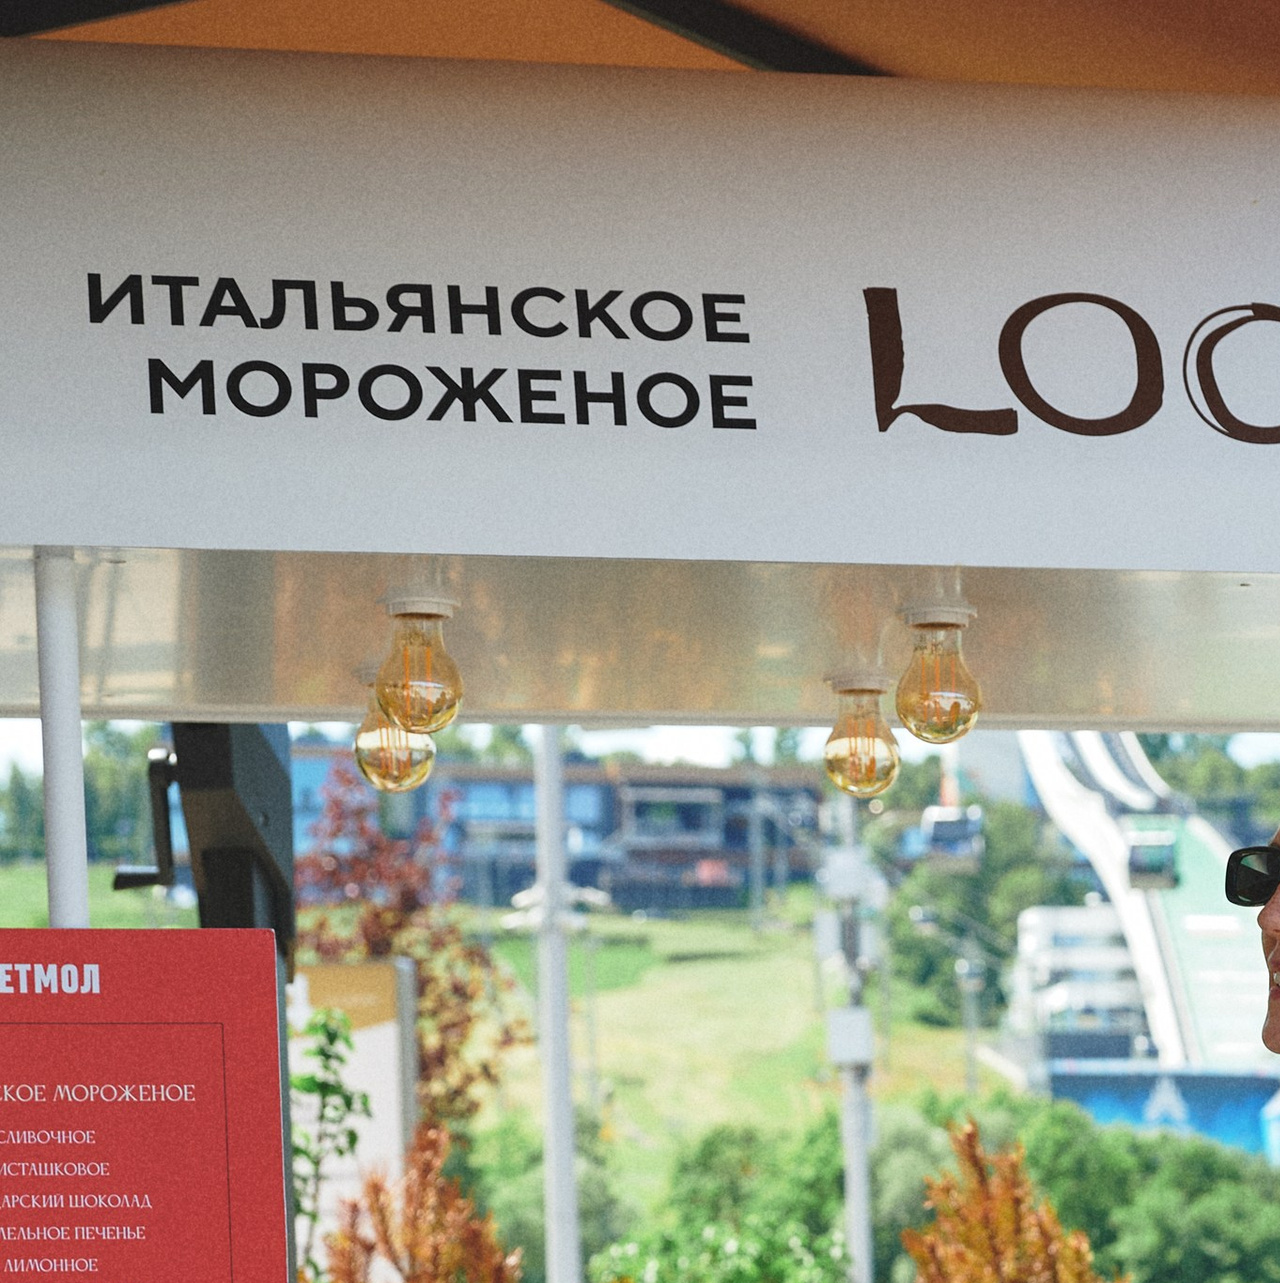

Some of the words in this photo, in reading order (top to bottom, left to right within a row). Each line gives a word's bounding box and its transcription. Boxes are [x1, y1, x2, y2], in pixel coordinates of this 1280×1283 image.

[87, 273, 750, 343] ИТАЛЬЯНСКОЕ
[148, 358, 756, 429] МОРОЖЕНОЕ
[0, 1083, 47, 1103] КОЕ
[53, 1083, 196, 1103] МОРОЖЕНОЕ
[1, 1194, 65, 1209] АРСКИЙ
[68, 1194, 153, 1209] ШОКОЛАД
[74, 1225, 146, 1240] ПЕЧЕНЬЕ
[3, 1258, 99, 1273] ЛИМОННОЕ
